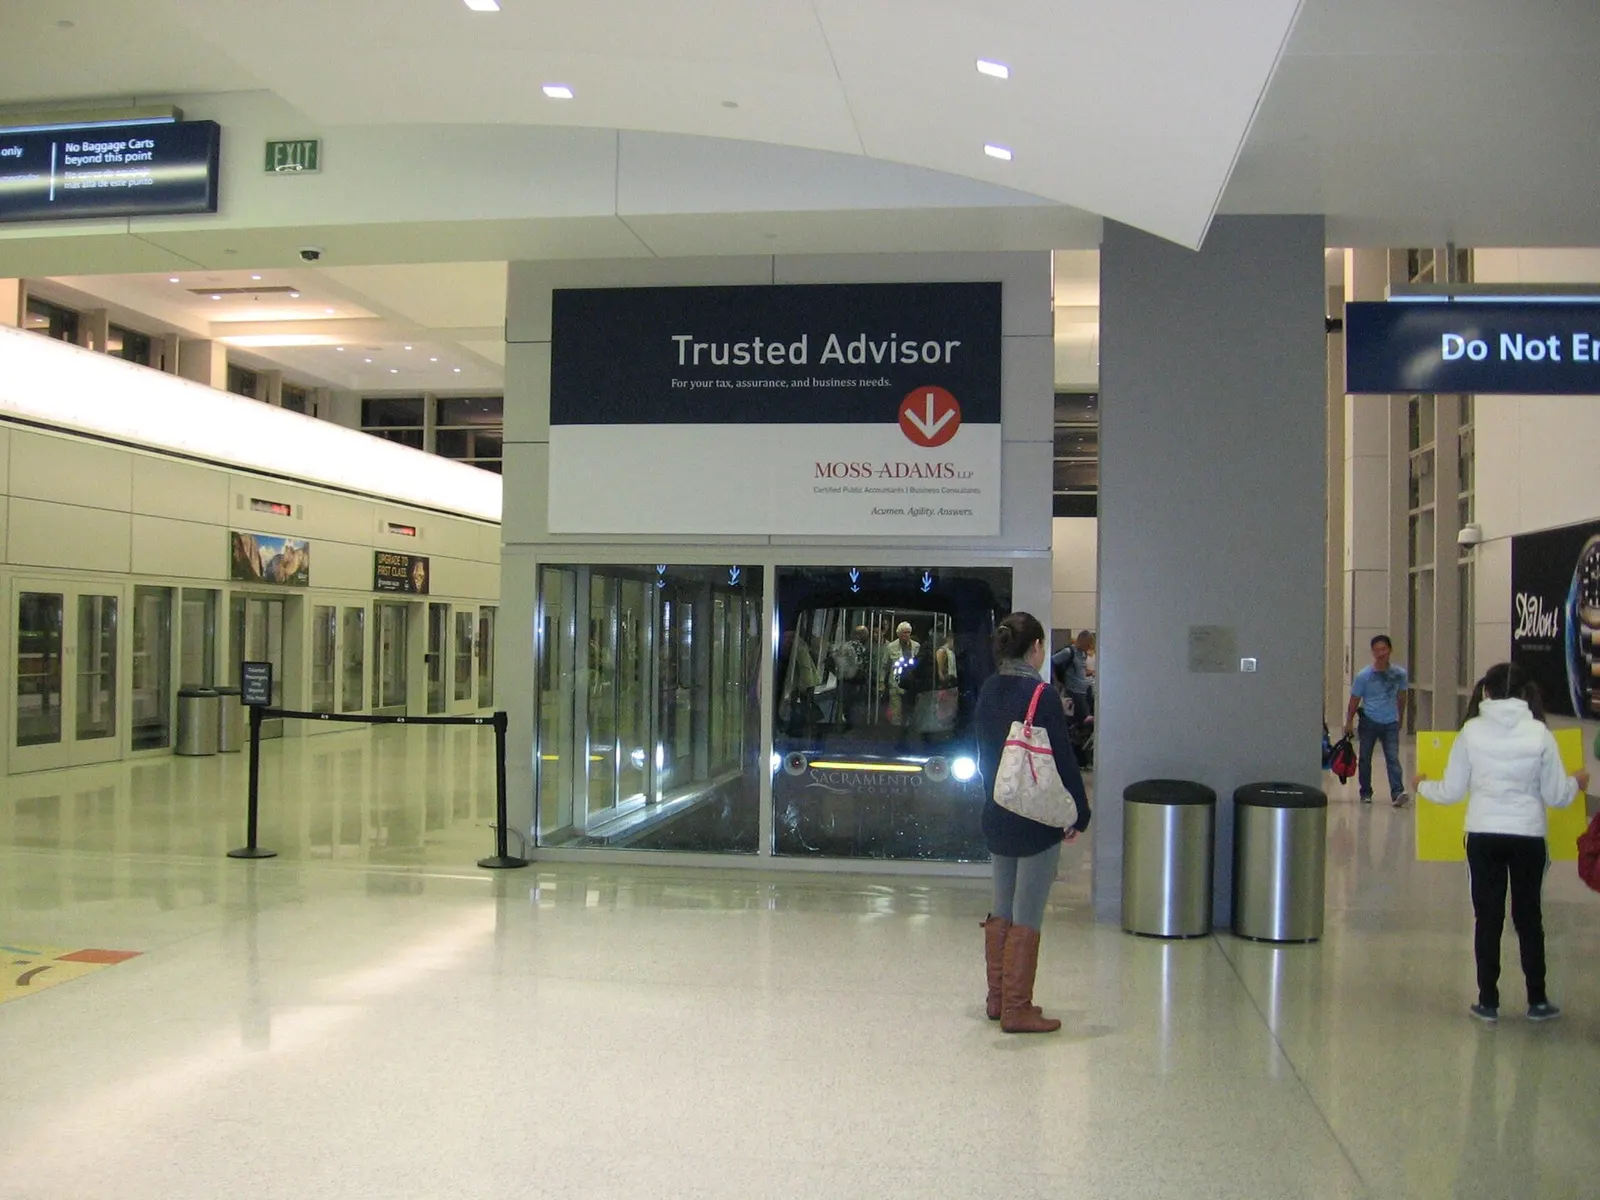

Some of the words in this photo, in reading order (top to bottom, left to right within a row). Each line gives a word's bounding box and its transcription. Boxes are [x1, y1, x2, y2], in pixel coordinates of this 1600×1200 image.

[1, 145, 23, 158] only
[65, 143, 80, 152] No
[82, 141, 126, 153] Baggage
[128, 139, 155, 149] Carts
[65, 153, 102, 166] beyond
[104, 152, 122, 163] this
[125, 151, 153, 163] point
[274, 143, 312, 169] EXIT
[671, 334, 808, 366] Trusted
[820, 332, 962, 365] Advisor
[1442, 333, 1488, 361] Do
[1500, 333, 1561, 362] Not
[671, 378, 688, 389] For
[690, 380, 714, 390] your
[716, 379, 734, 389] tax,
[736, 379, 789, 389] assurance,
[791, 377, 810, 388] and
[812, 377, 857, 388] business
[859, 377, 892, 387] needs.
[814, 462, 873, 479] MOSS
[957, 471, 974, 479] LLP
[813, 486, 842, 494] Certified
[843, 486, 863, 494] Public
[910, 487, 940, 495] Business
[941, 487, 981, 495] Consultants
[871, 506, 905, 516] Acumen.
[907, 507, 936, 518] Agility.
[937, 507, 974, 517] Answers.
[378, 553, 400, 565] UPGRADE
[378, 565, 391, 576] FIRST
